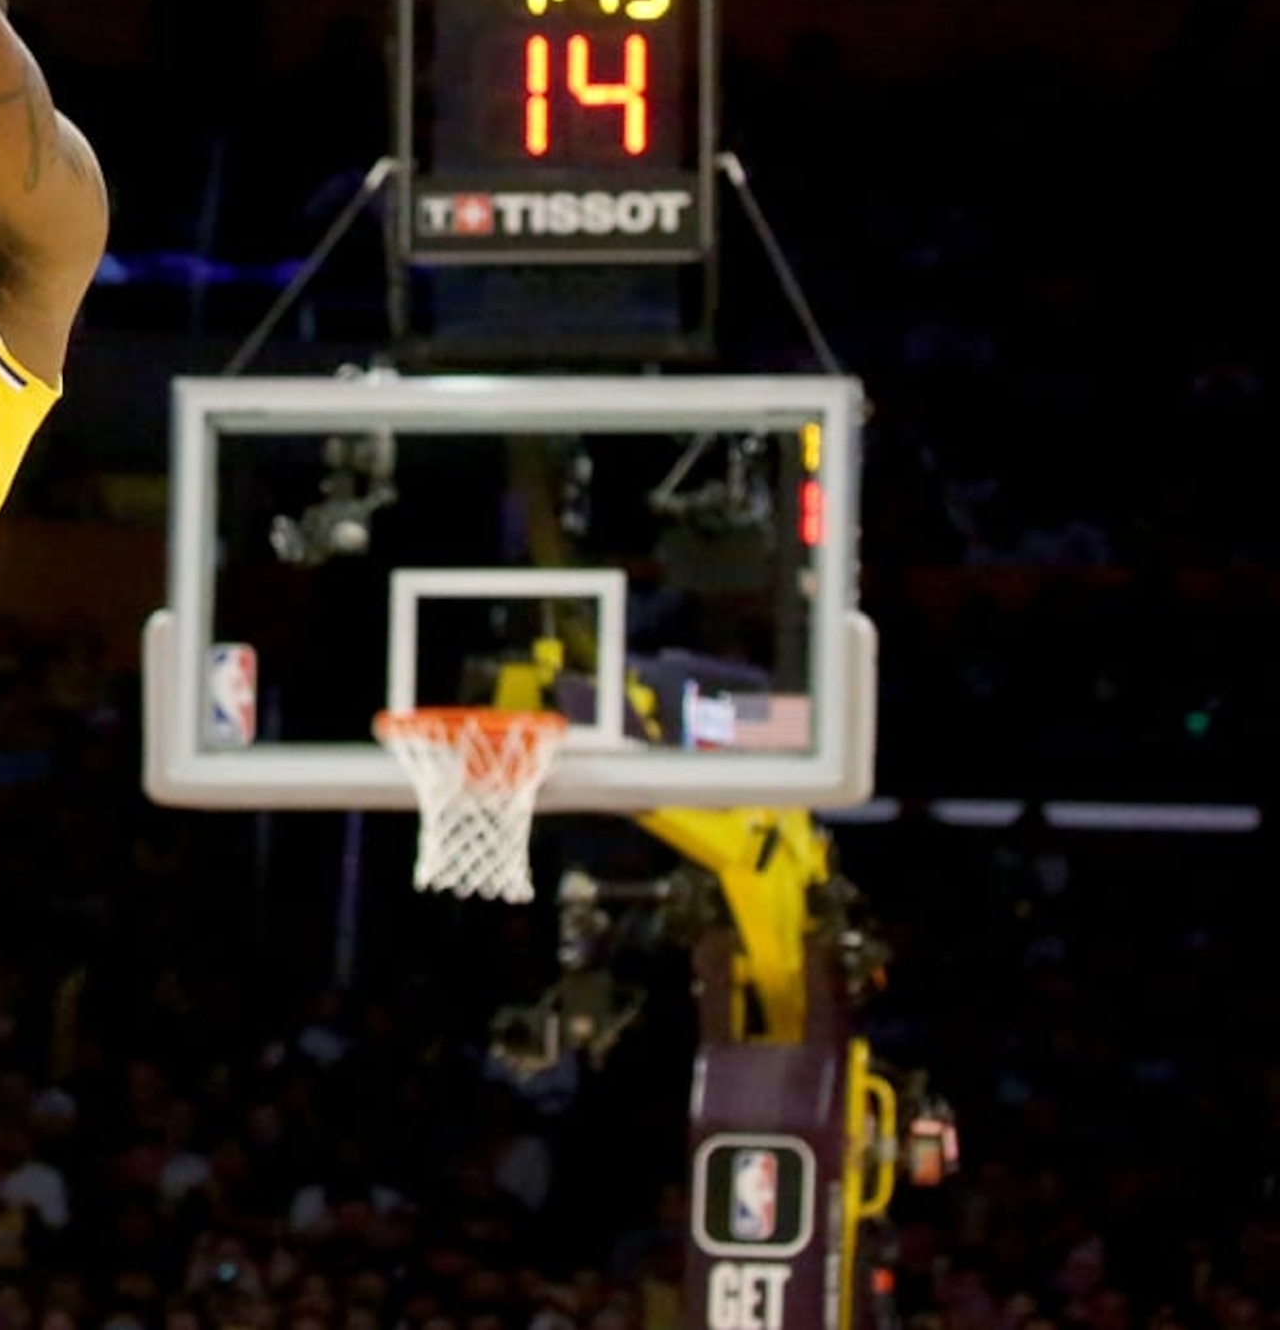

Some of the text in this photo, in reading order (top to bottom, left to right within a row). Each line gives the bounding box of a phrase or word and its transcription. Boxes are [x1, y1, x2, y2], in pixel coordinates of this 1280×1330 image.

[525, 32, 649, 156] 14
[496, 192, 690, 234] TISSOT
[707, 1261, 793, 1330] GET
